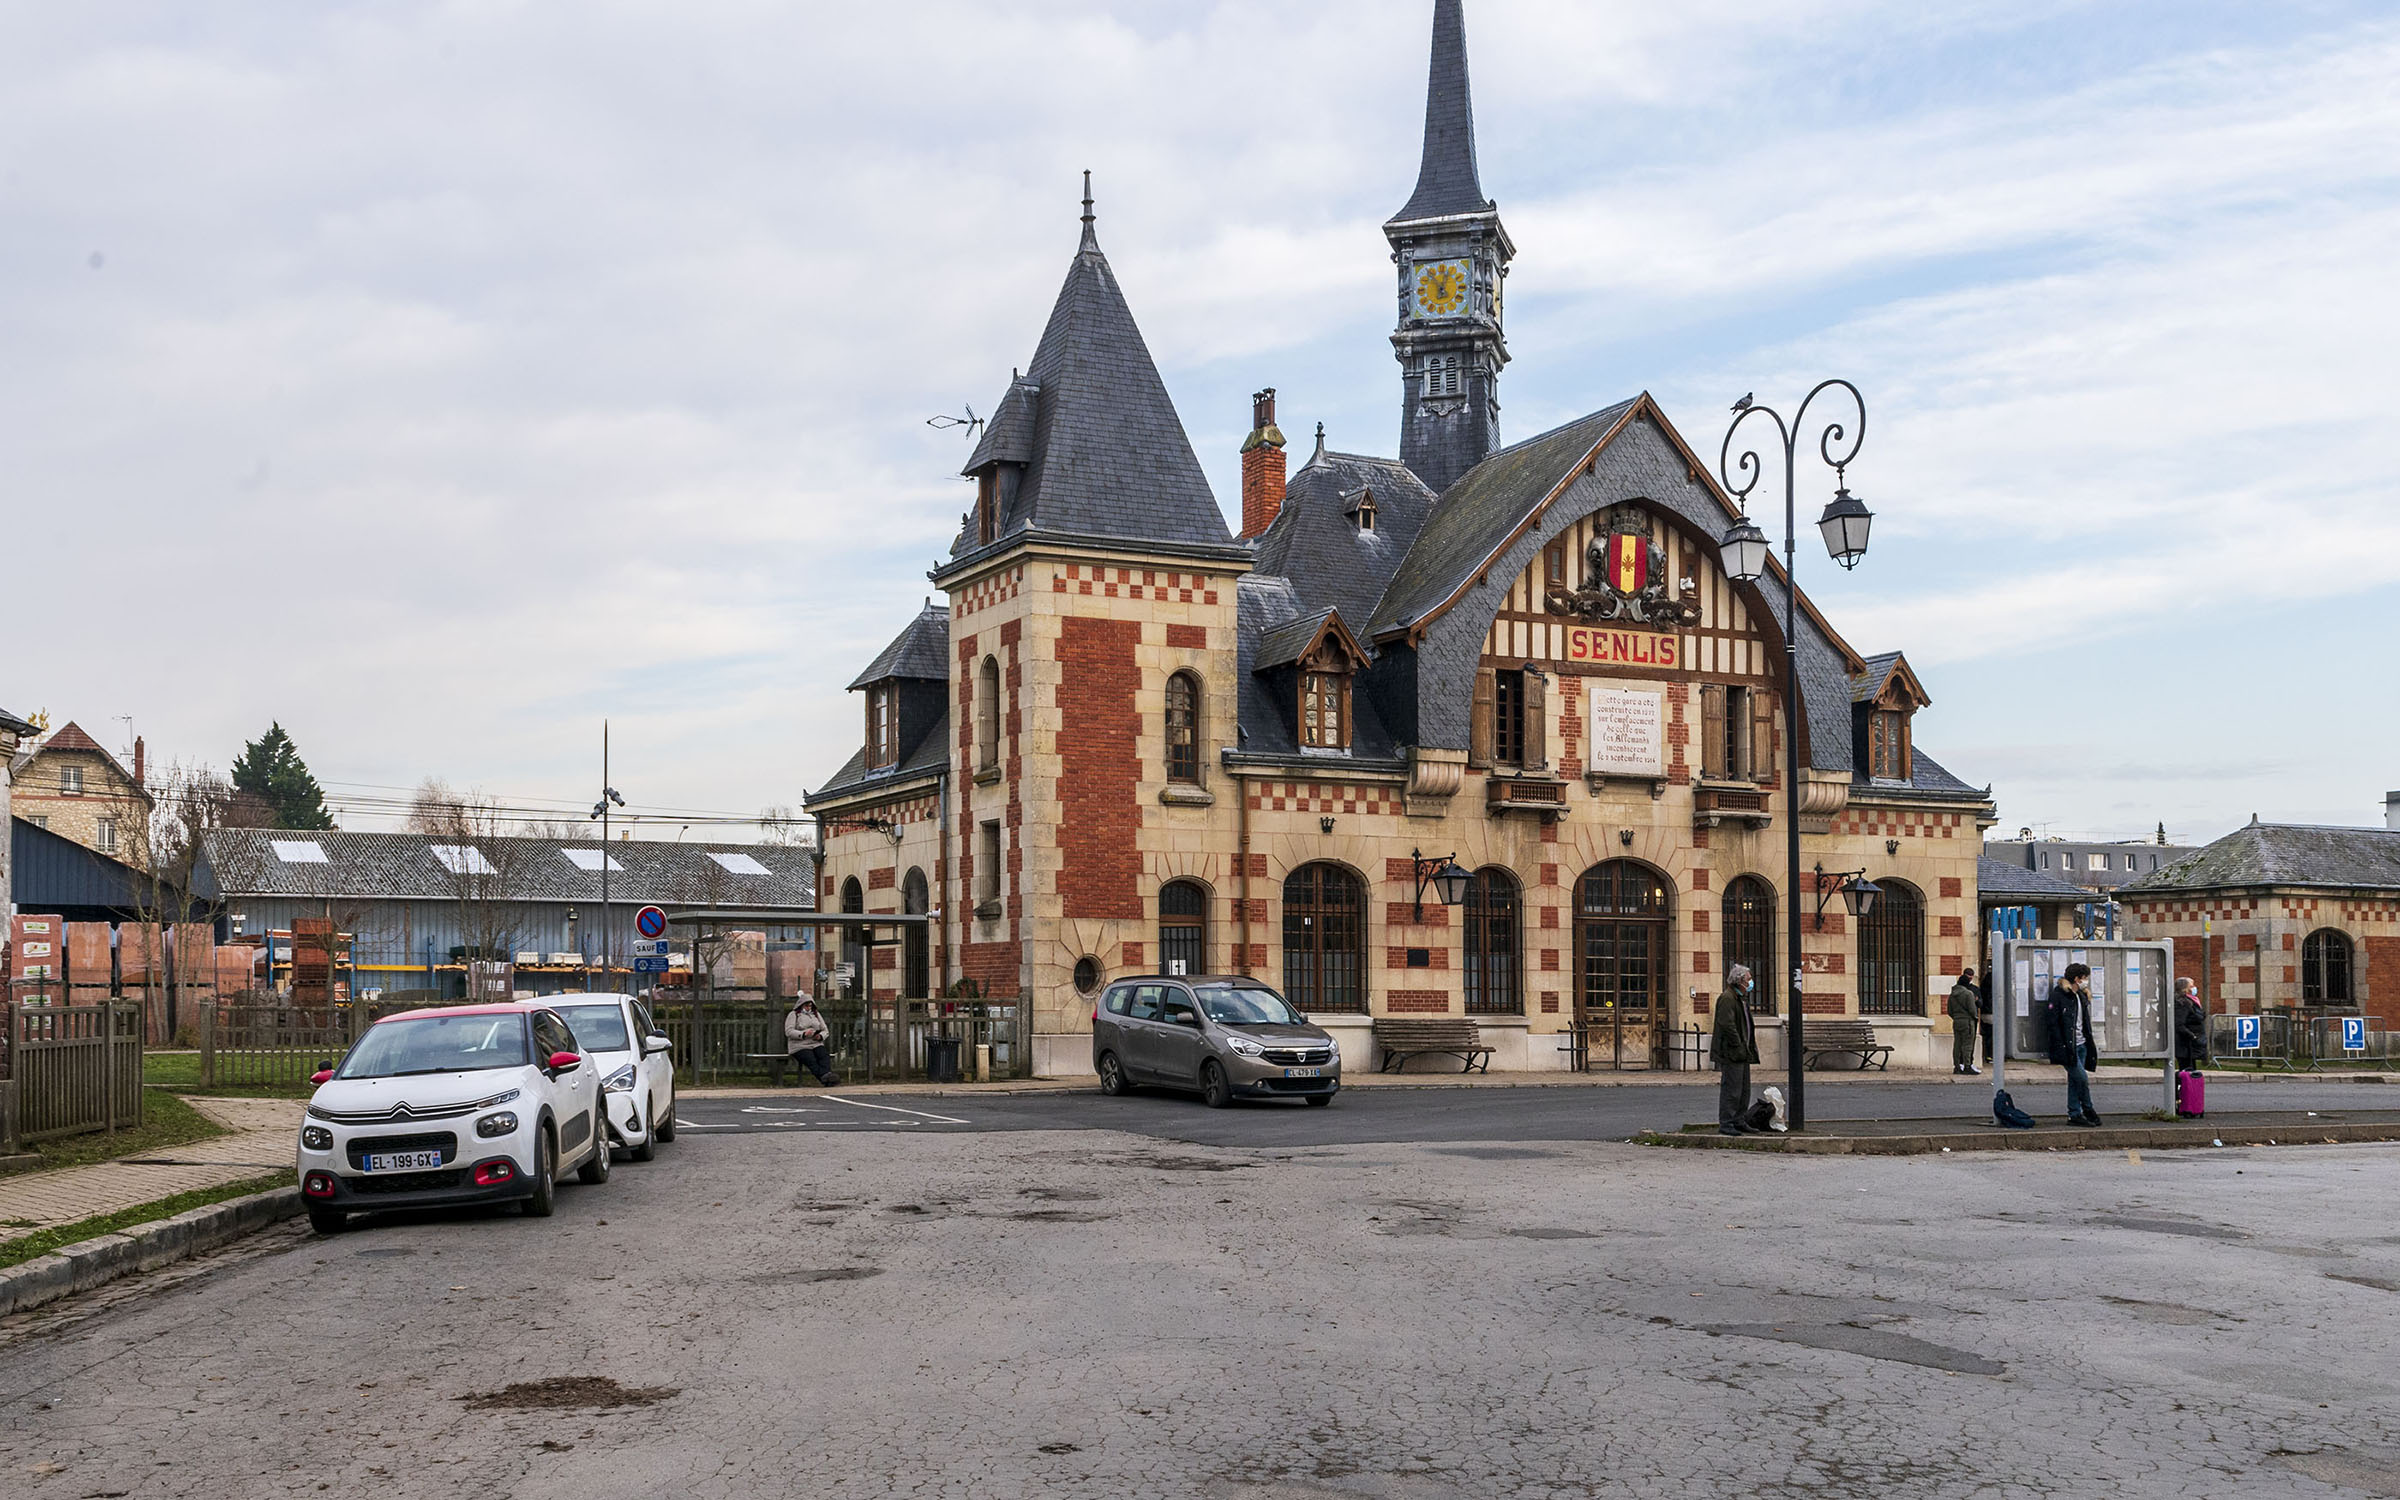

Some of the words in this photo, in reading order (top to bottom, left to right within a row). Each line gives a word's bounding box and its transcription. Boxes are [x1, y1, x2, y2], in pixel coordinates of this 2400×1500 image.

[1572, 630, 1675, 665] SENLIS
[2243, 1020, 2254, 1040] P
[2348, 1021, 2359, 1040] P
[372, 1153, 432, 1170] EL-199-GX
